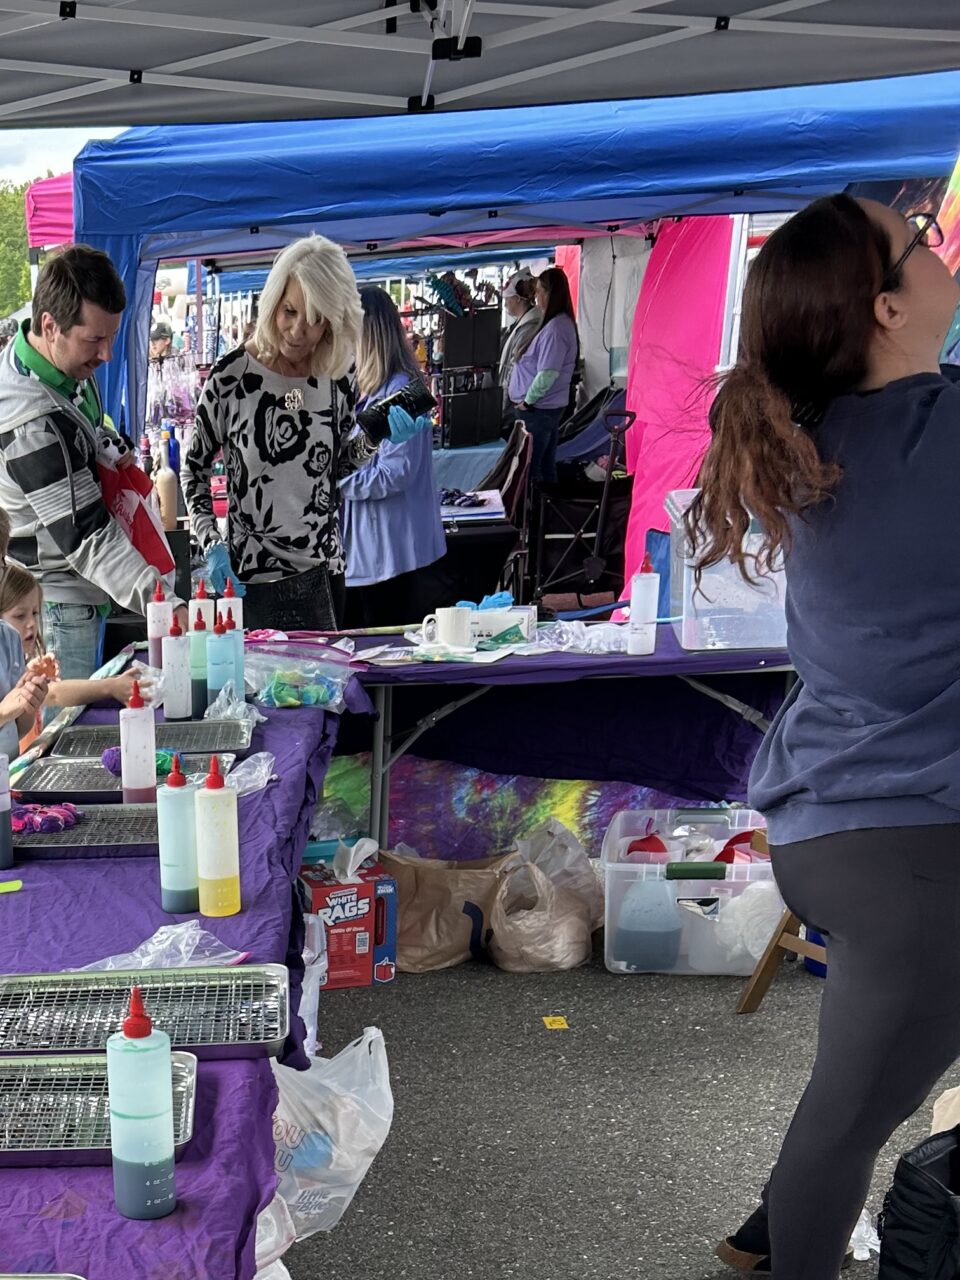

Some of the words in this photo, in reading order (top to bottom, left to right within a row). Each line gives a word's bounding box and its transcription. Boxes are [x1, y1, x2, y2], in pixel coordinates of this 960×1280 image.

[318, 897, 370, 927] RAGS
[325, 893, 358, 907] WHITE
[272, 1114, 307, 1150] OU
